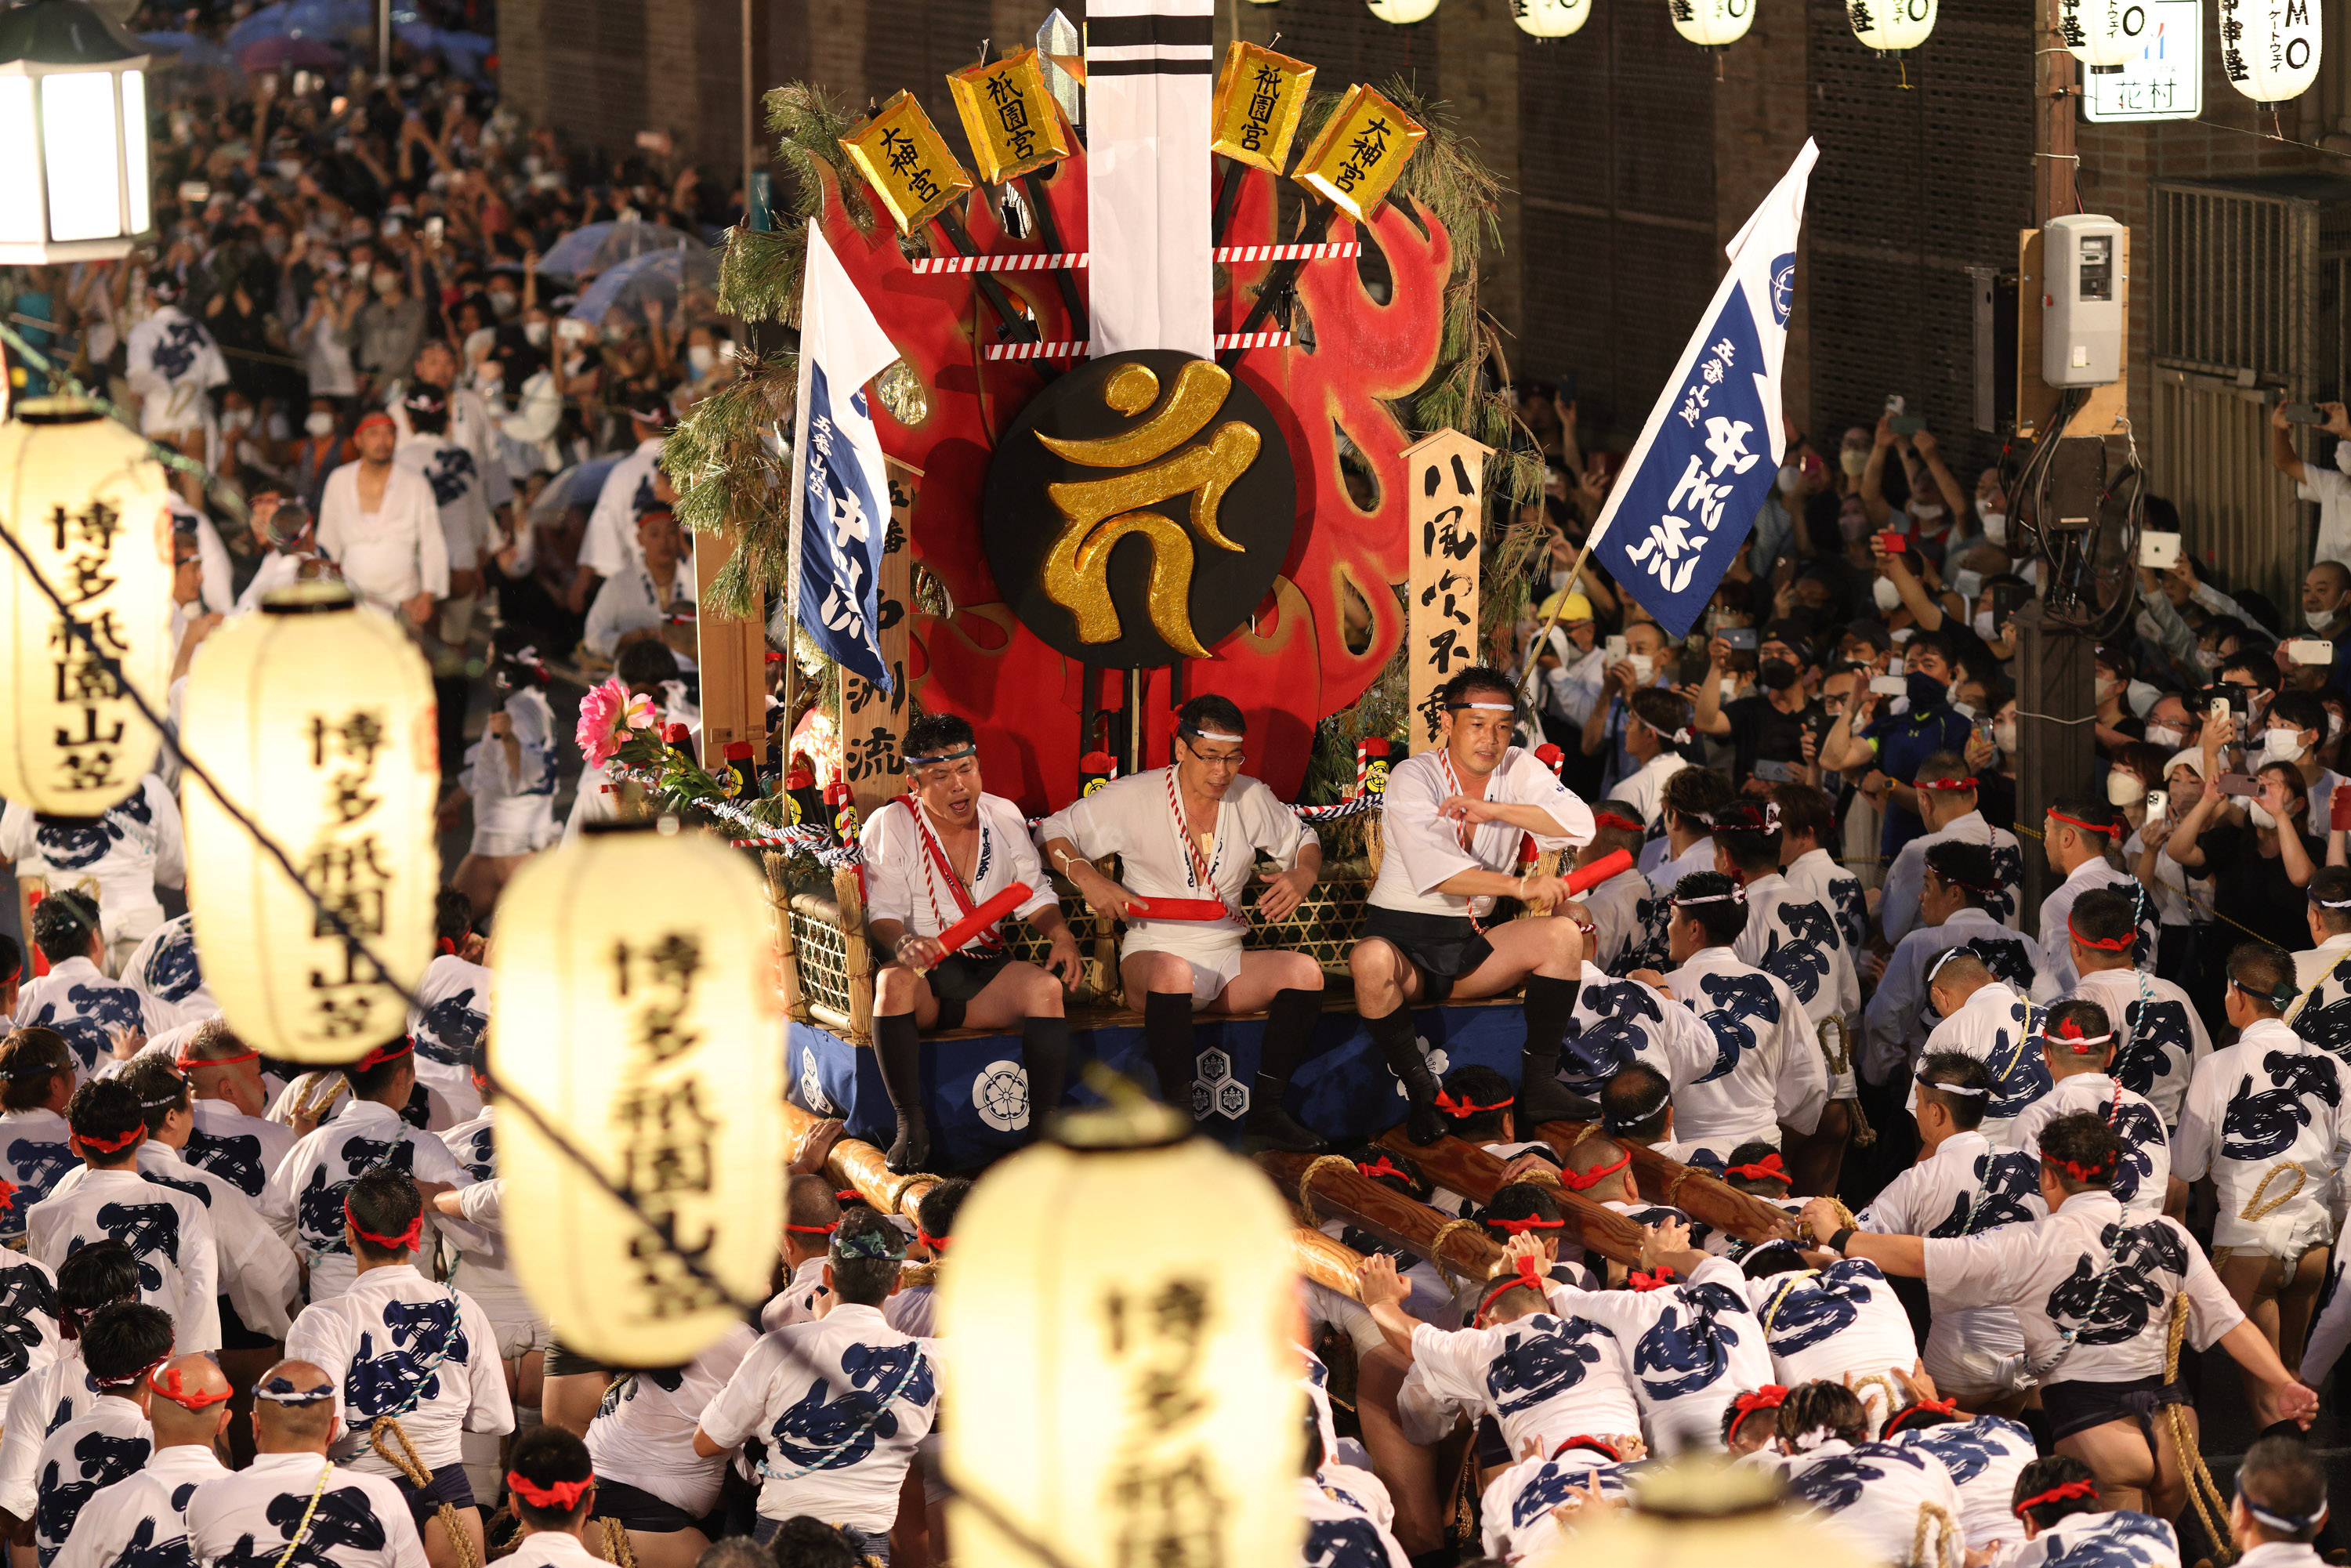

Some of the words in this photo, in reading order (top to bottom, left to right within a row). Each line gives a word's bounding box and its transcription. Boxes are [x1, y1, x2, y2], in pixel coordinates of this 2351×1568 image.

[2116, 78, 2177, 109] 花村
[880, 127, 942, 204] 大神宮
[1331, 117, 1391, 195] 大神宮
[809, 414, 834, 502] 五番山笠
[45, 502, 129, 791] 博多祇園山笠
